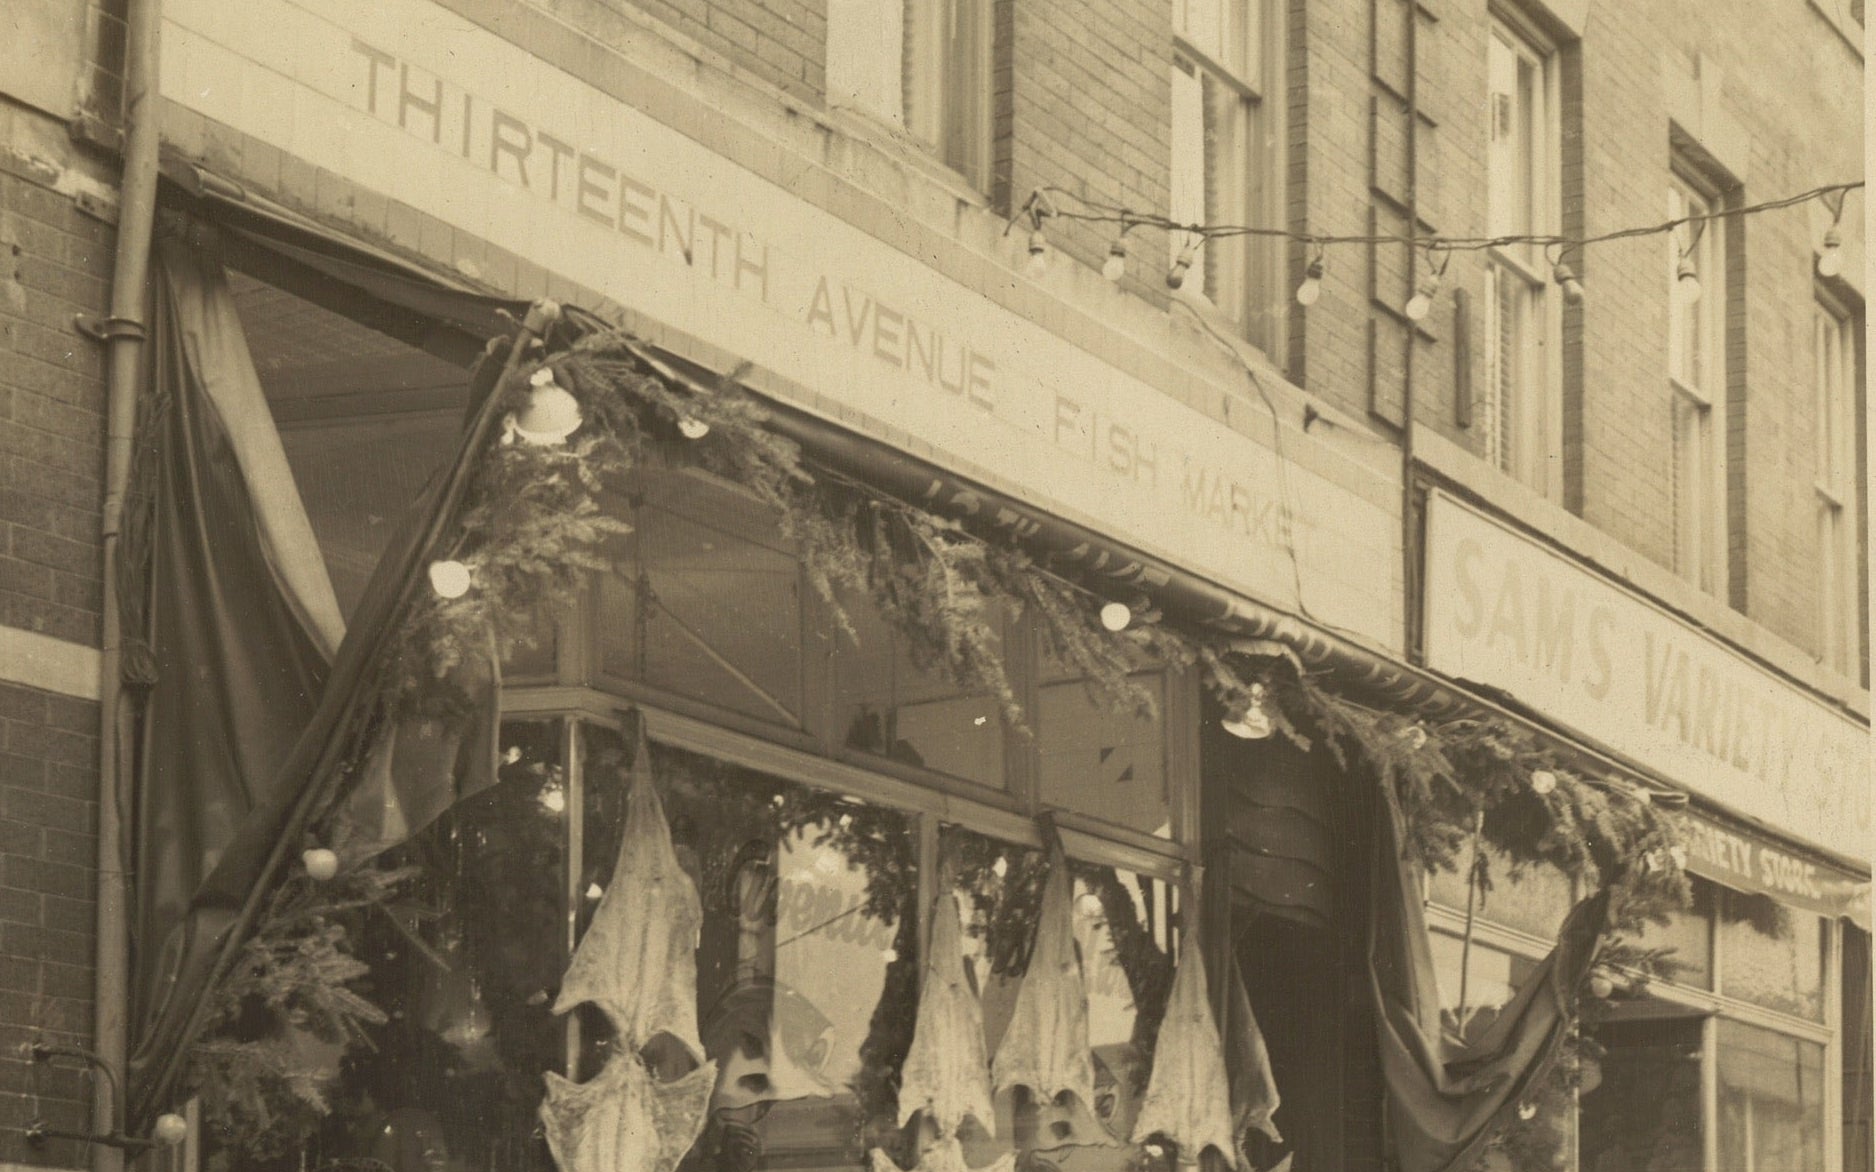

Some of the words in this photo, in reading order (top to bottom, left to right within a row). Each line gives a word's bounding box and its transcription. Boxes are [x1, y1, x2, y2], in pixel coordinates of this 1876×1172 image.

[350, 37, 770, 302] THIRTEENTH
[806, 275, 996, 413] AVENUE
[1053, 388, 1158, 489] FISH
